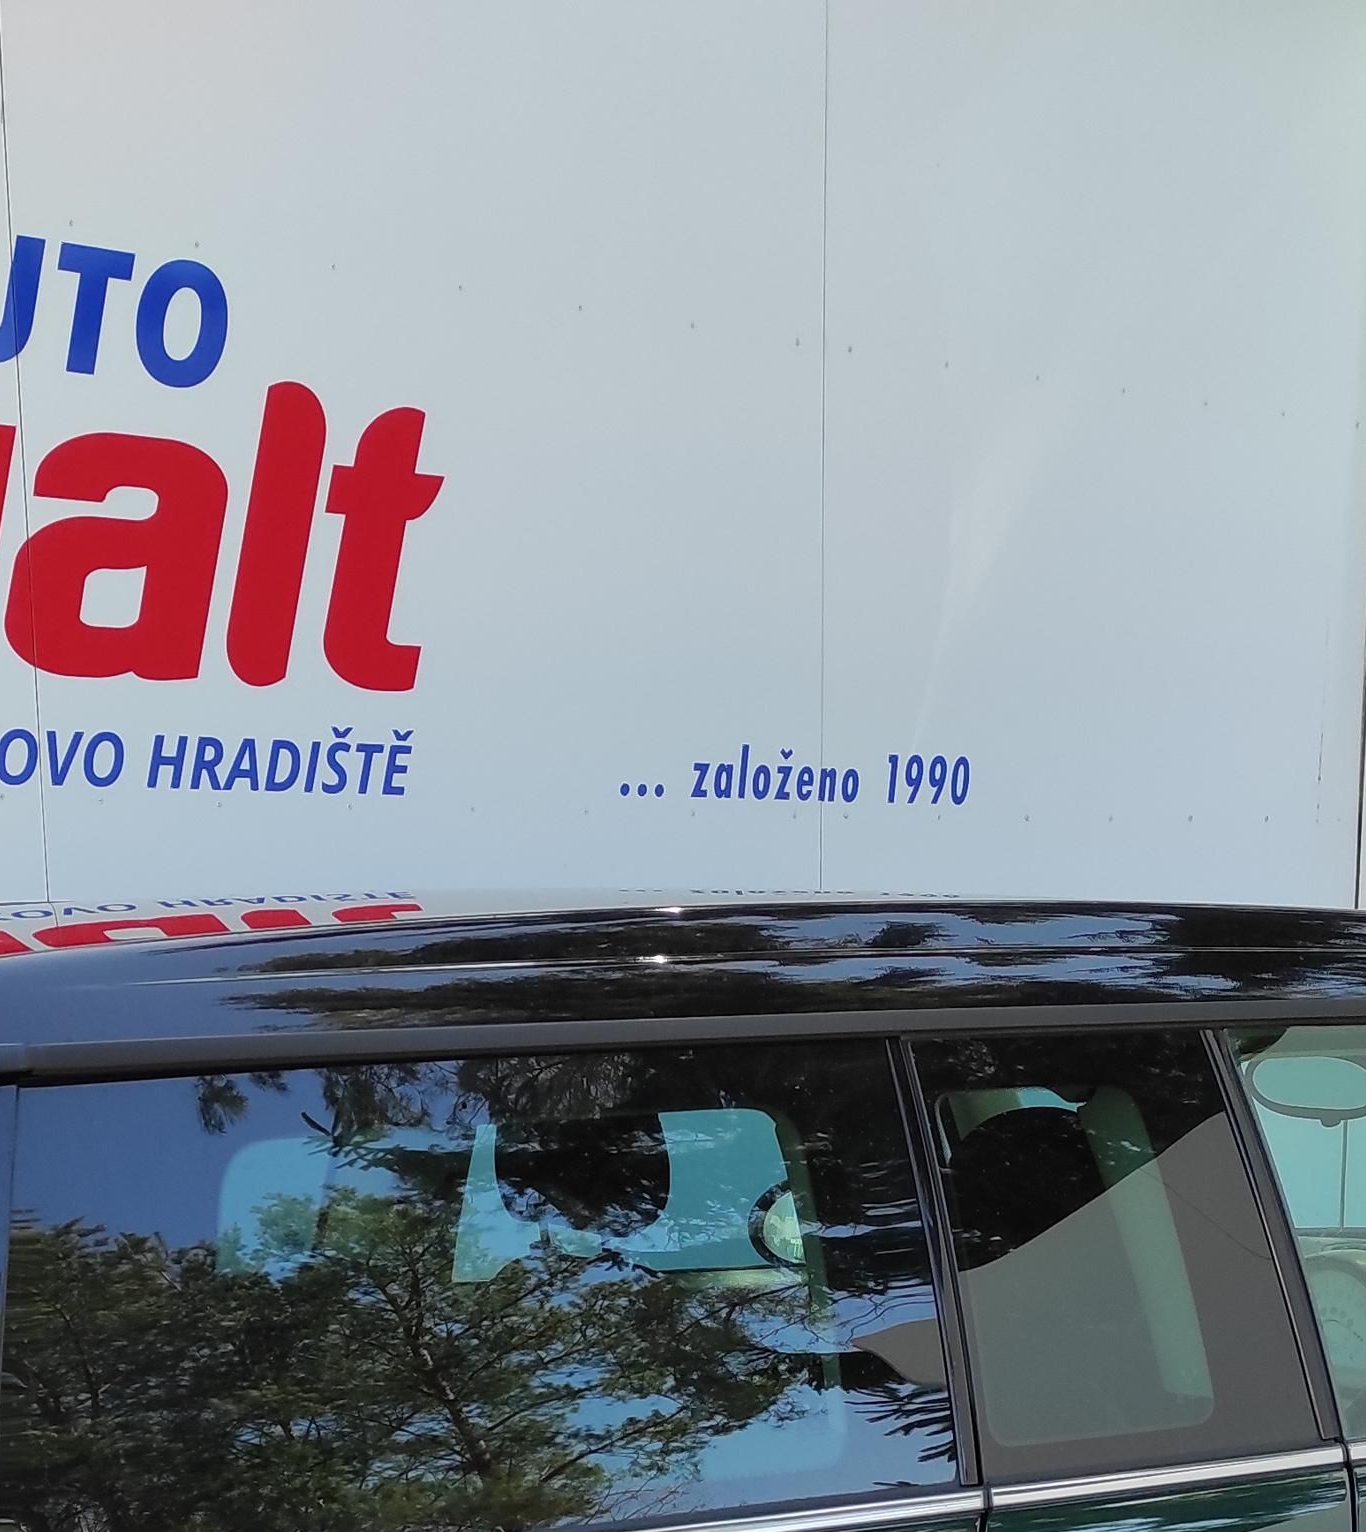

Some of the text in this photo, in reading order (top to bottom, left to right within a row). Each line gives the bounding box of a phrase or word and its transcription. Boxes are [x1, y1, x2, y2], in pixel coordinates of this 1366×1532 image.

[147, 726, 415, 797] HRADIŠTĚ
[690, 744, 860, 804] založeno
[886, 753, 971, 806] 1990
